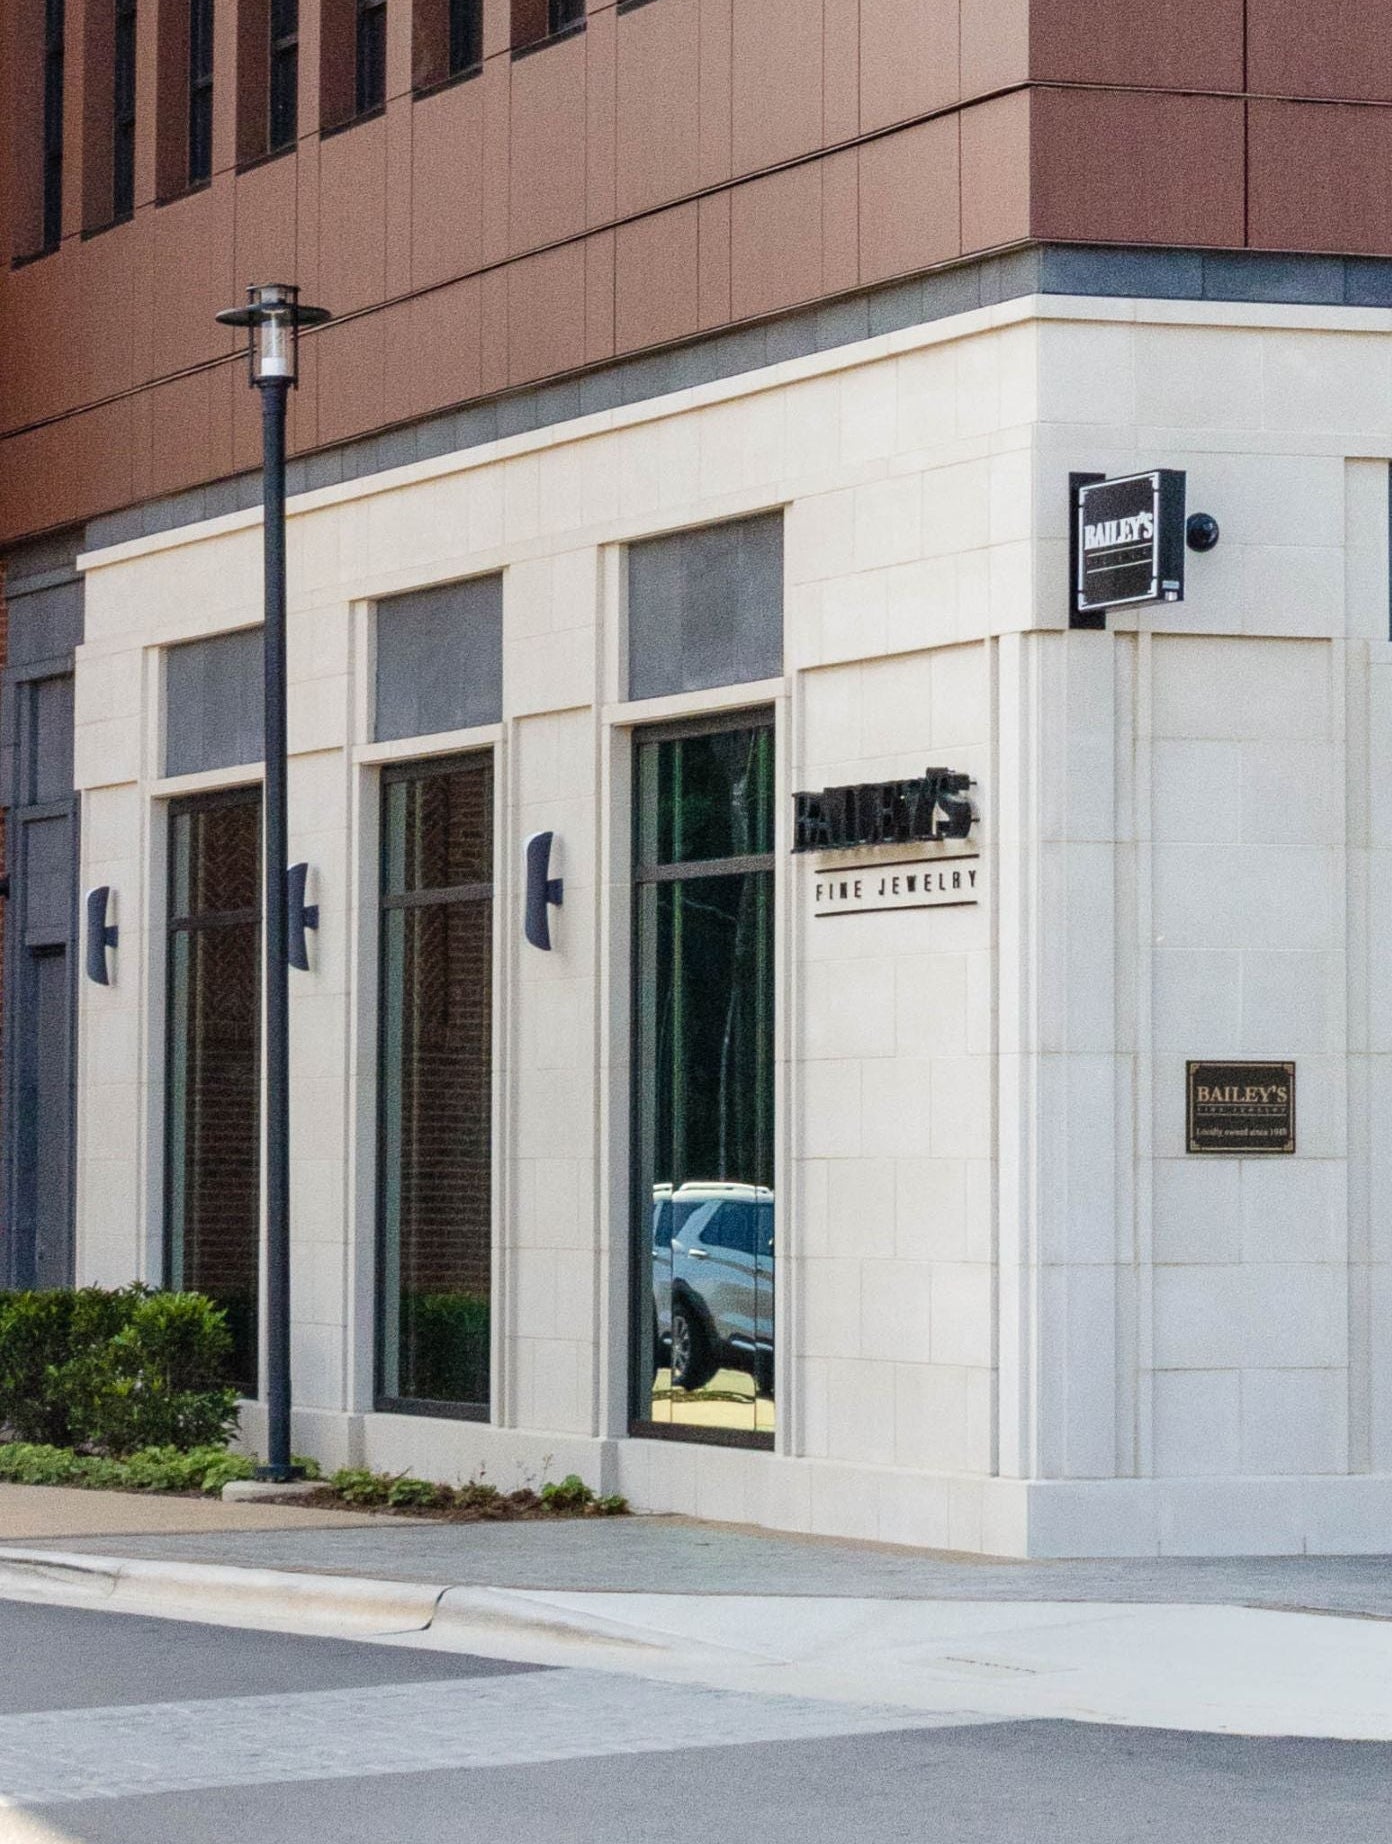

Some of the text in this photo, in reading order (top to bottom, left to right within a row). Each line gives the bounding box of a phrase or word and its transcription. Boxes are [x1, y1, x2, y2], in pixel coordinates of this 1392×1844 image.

[1084, 511, 1153, 550] BAILEY'S
[816, 869, 977, 902] FINE JEWELRY
[1197, 1085, 1288, 1103] BAILEY'S
